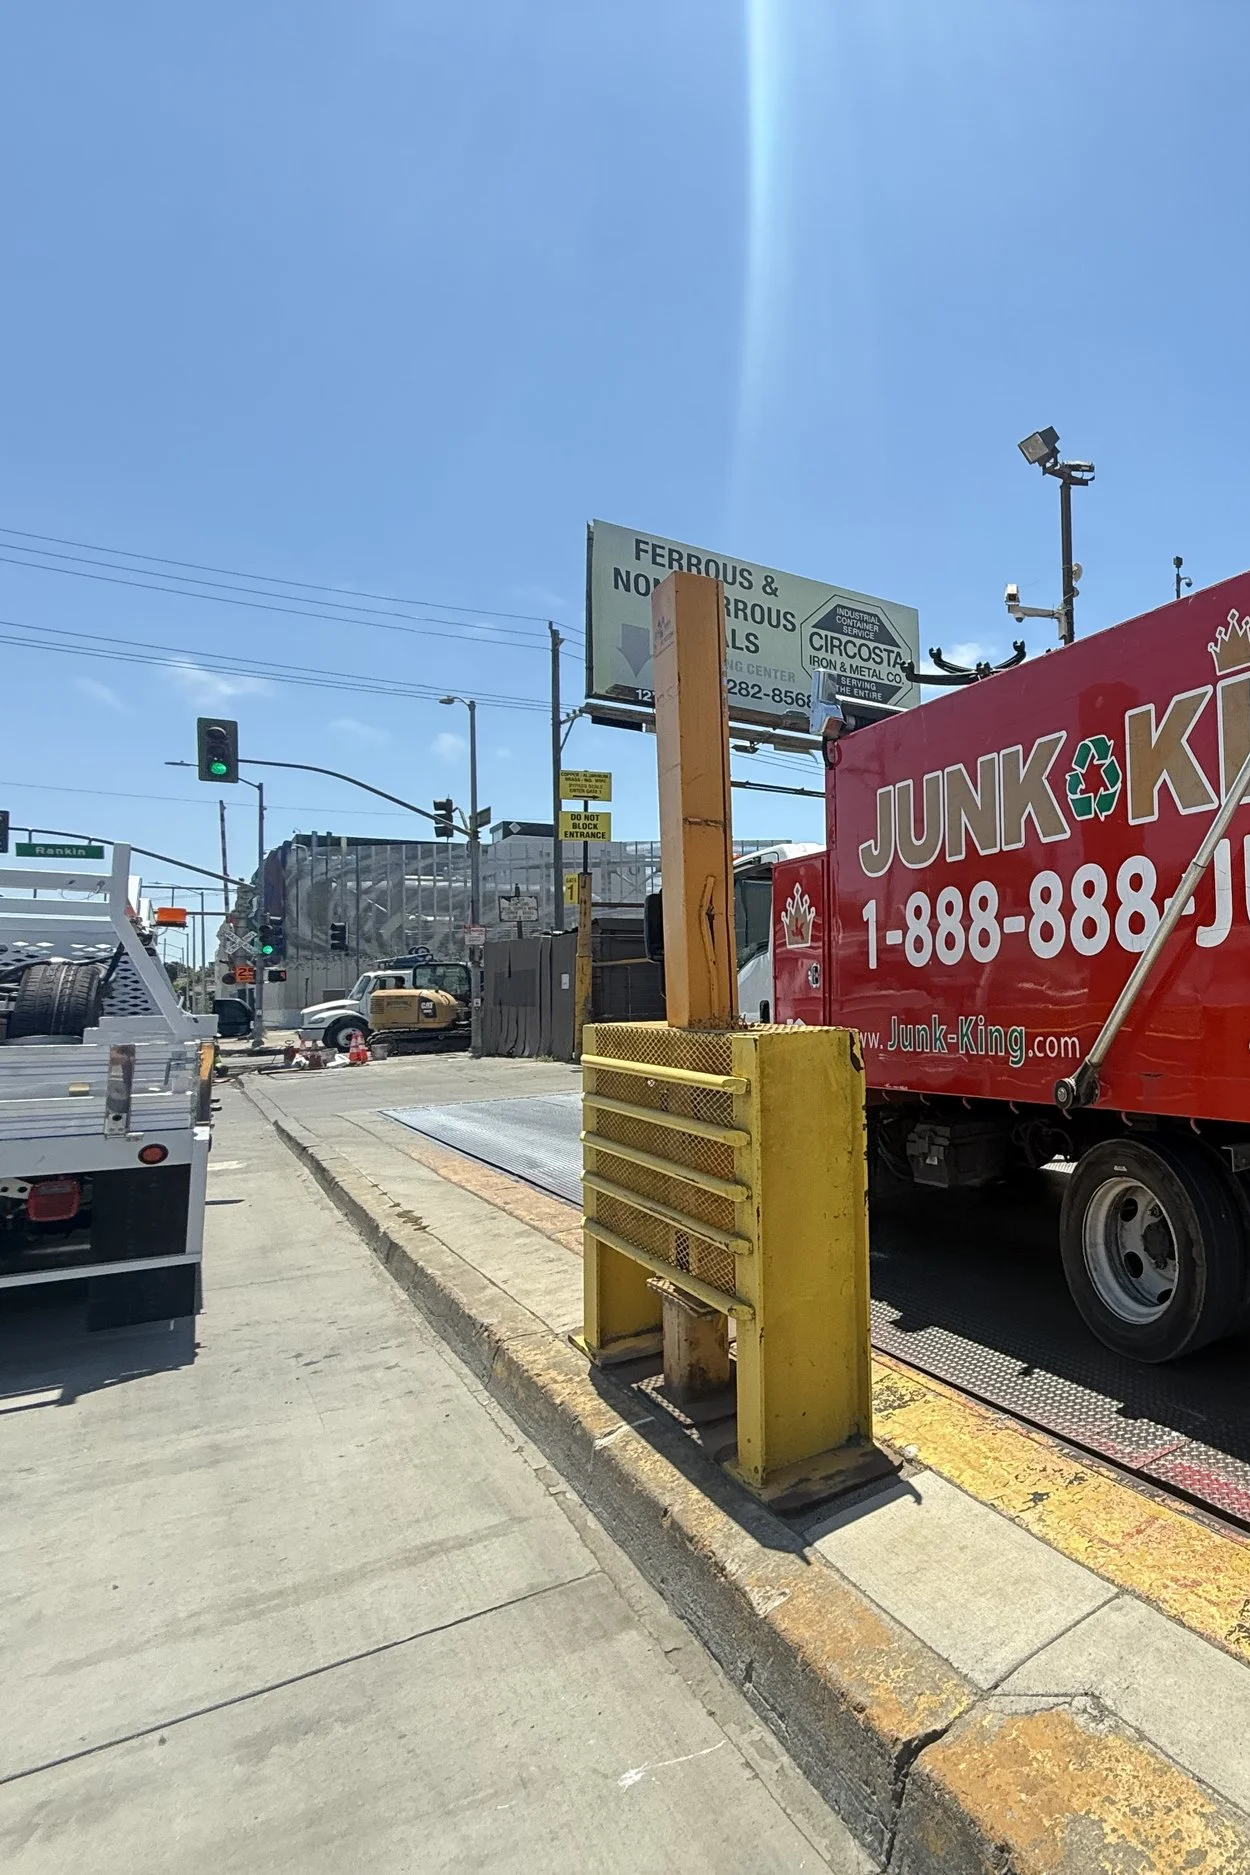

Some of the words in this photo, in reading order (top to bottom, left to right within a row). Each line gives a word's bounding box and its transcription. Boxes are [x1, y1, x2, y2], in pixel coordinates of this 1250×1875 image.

[634, 538, 754, 590] FERROUS
[762, 574, 779, 598] &
[836, 607, 880, 625] INDUSTRIAL
[835, 616, 880, 633] CONTAINER
[842, 625, 875, 640] SERVICE
[809, 631, 904, 669] CIRCOSTA
[747, 663, 796, 683] CENTER
[809, 654, 837, 671] IRON
[839, 662, 847, 673] &
[850, 663, 885, 681] METAL
[840, 676, 877, 691] SERVING
[853, 688, 883, 700] ENTIRE
[859, 731, 1071, 877] JUNK
[570, 813, 582, 821] DO
[584, 814, 600, 822] NOT
[572, 822, 599, 830] BLOCK
[564, 831, 606, 839] ENTRANCE
[35, 846, 86, 856] Rankin
[568, 885, 574, 901] 1
[421, 1001, 434, 1009] CAT
